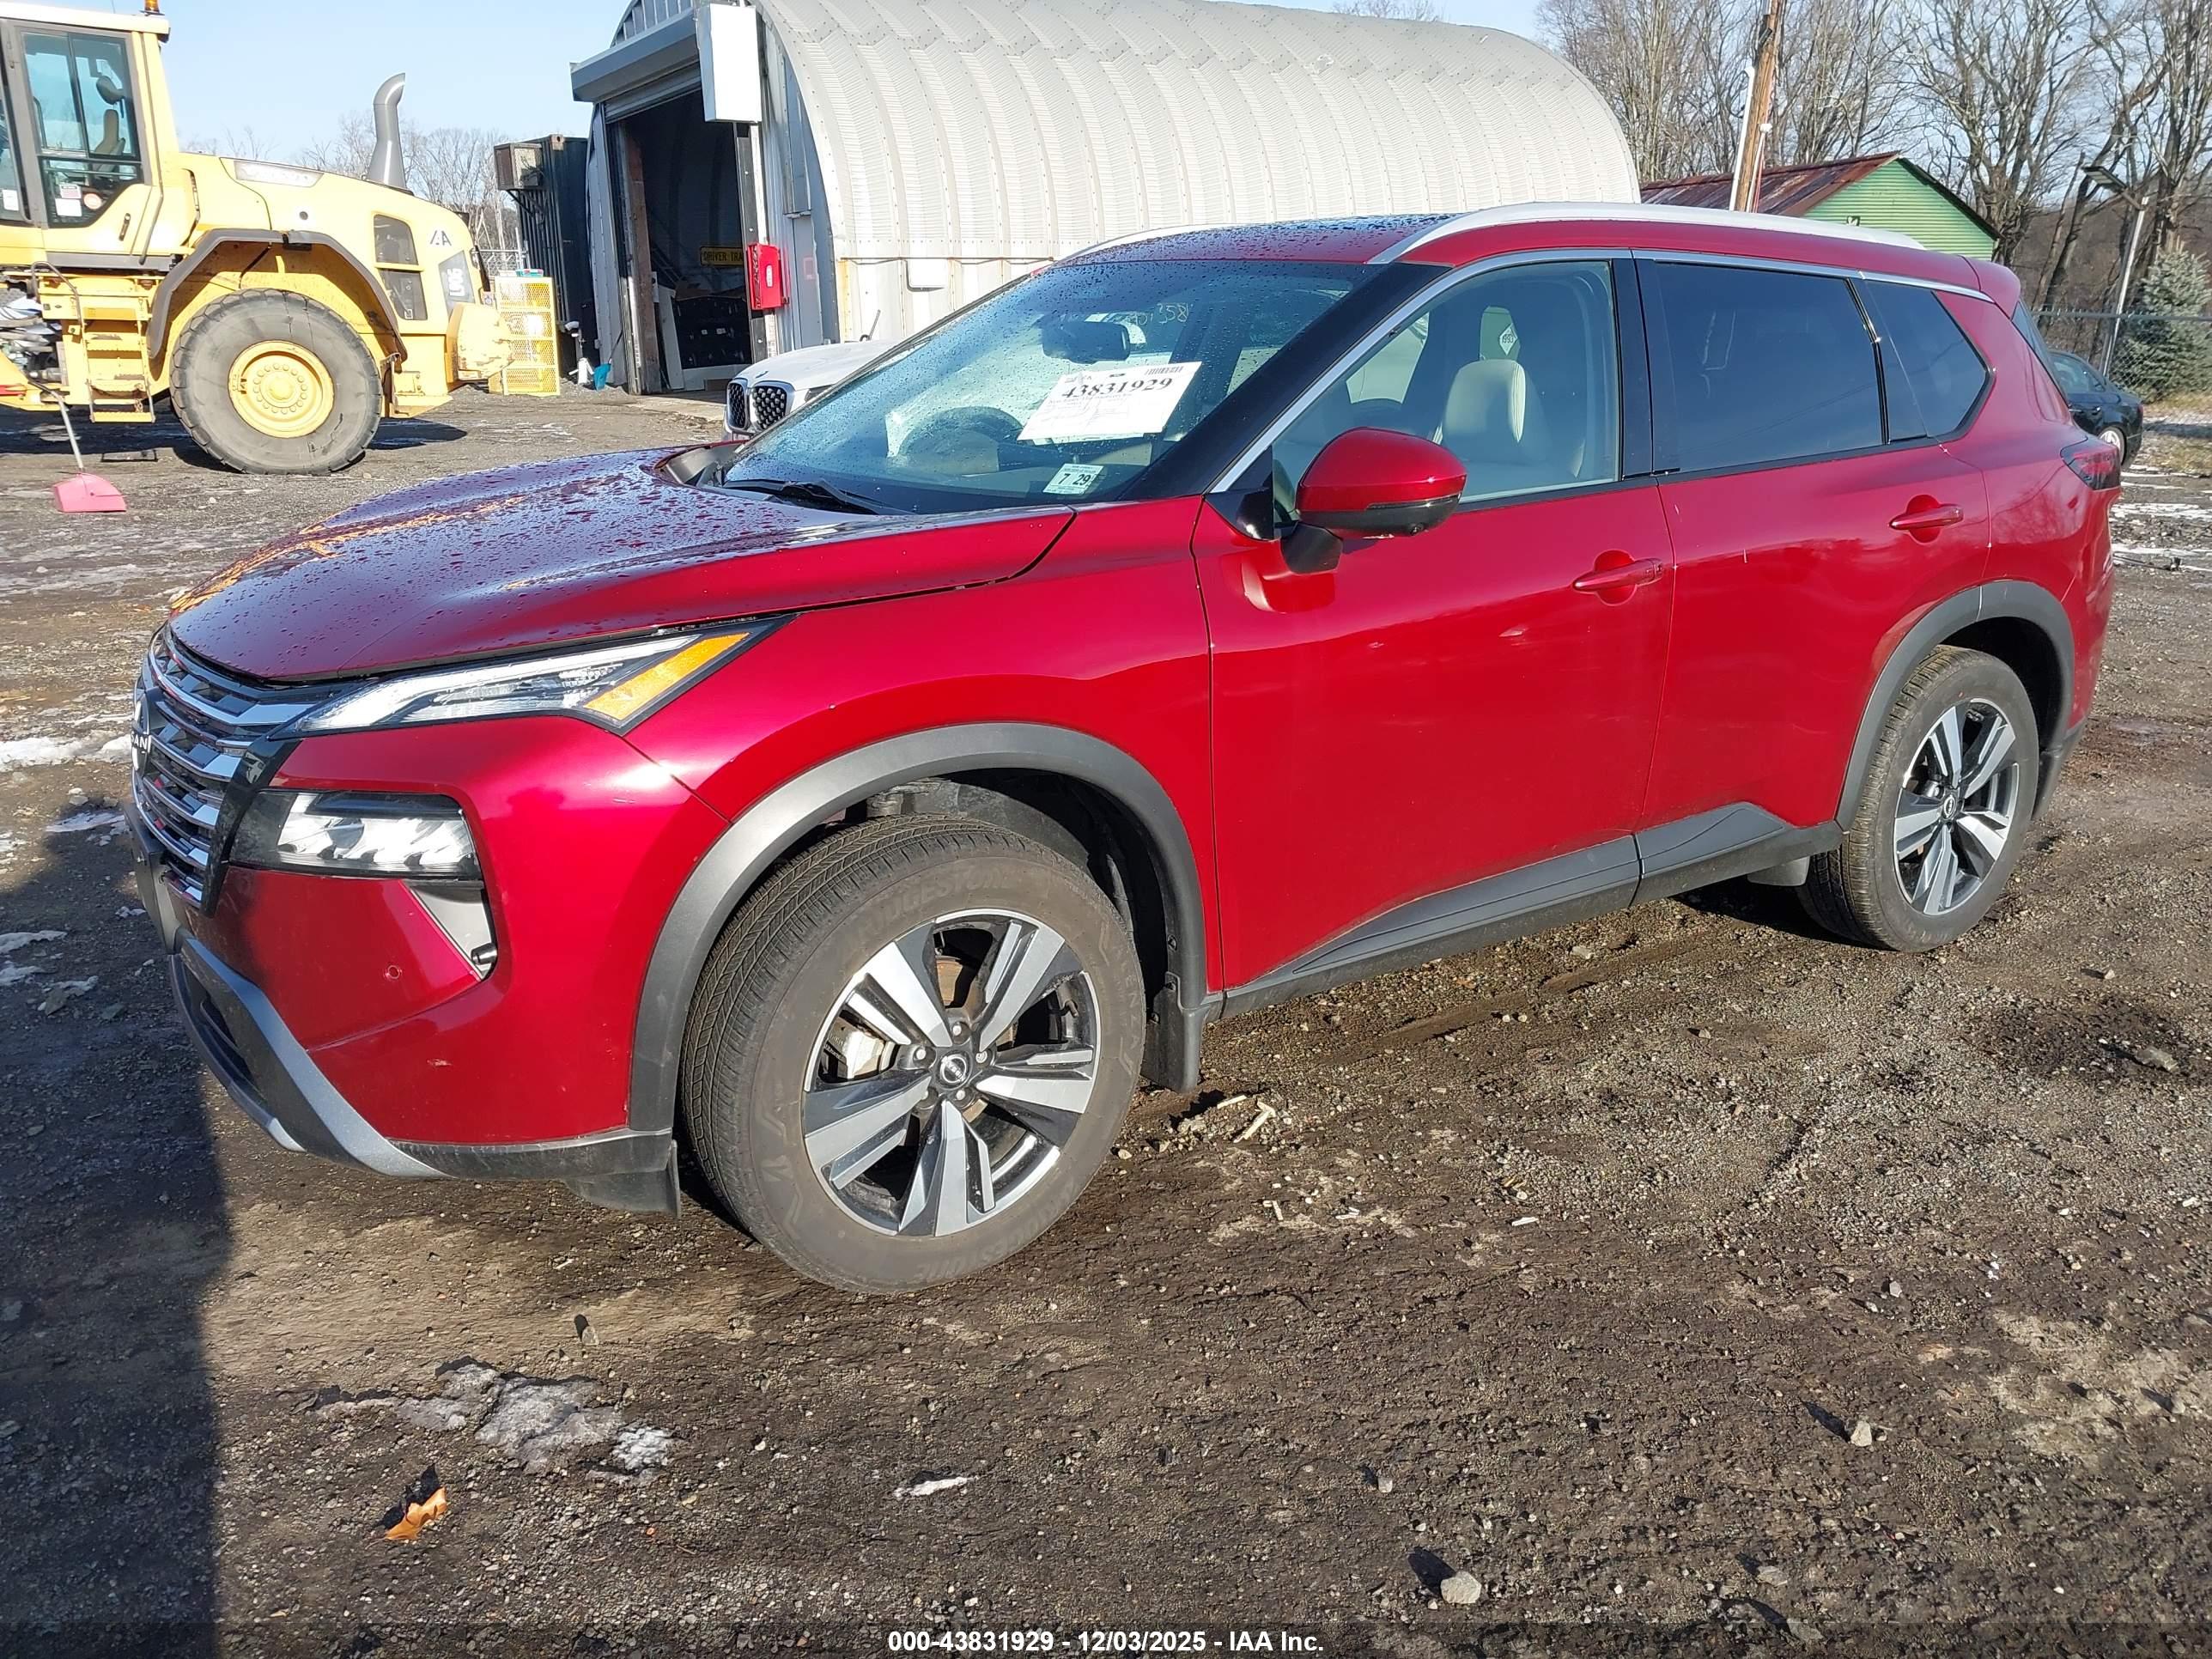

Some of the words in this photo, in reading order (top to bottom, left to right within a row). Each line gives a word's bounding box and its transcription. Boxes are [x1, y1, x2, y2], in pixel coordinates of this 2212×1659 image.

[703, 251, 727, 261] DRIVER
[1062, 378, 1173, 398] 43831929
[1058, 473, 1072, 485] 7
[1073, 474, 1091, 486] 29
